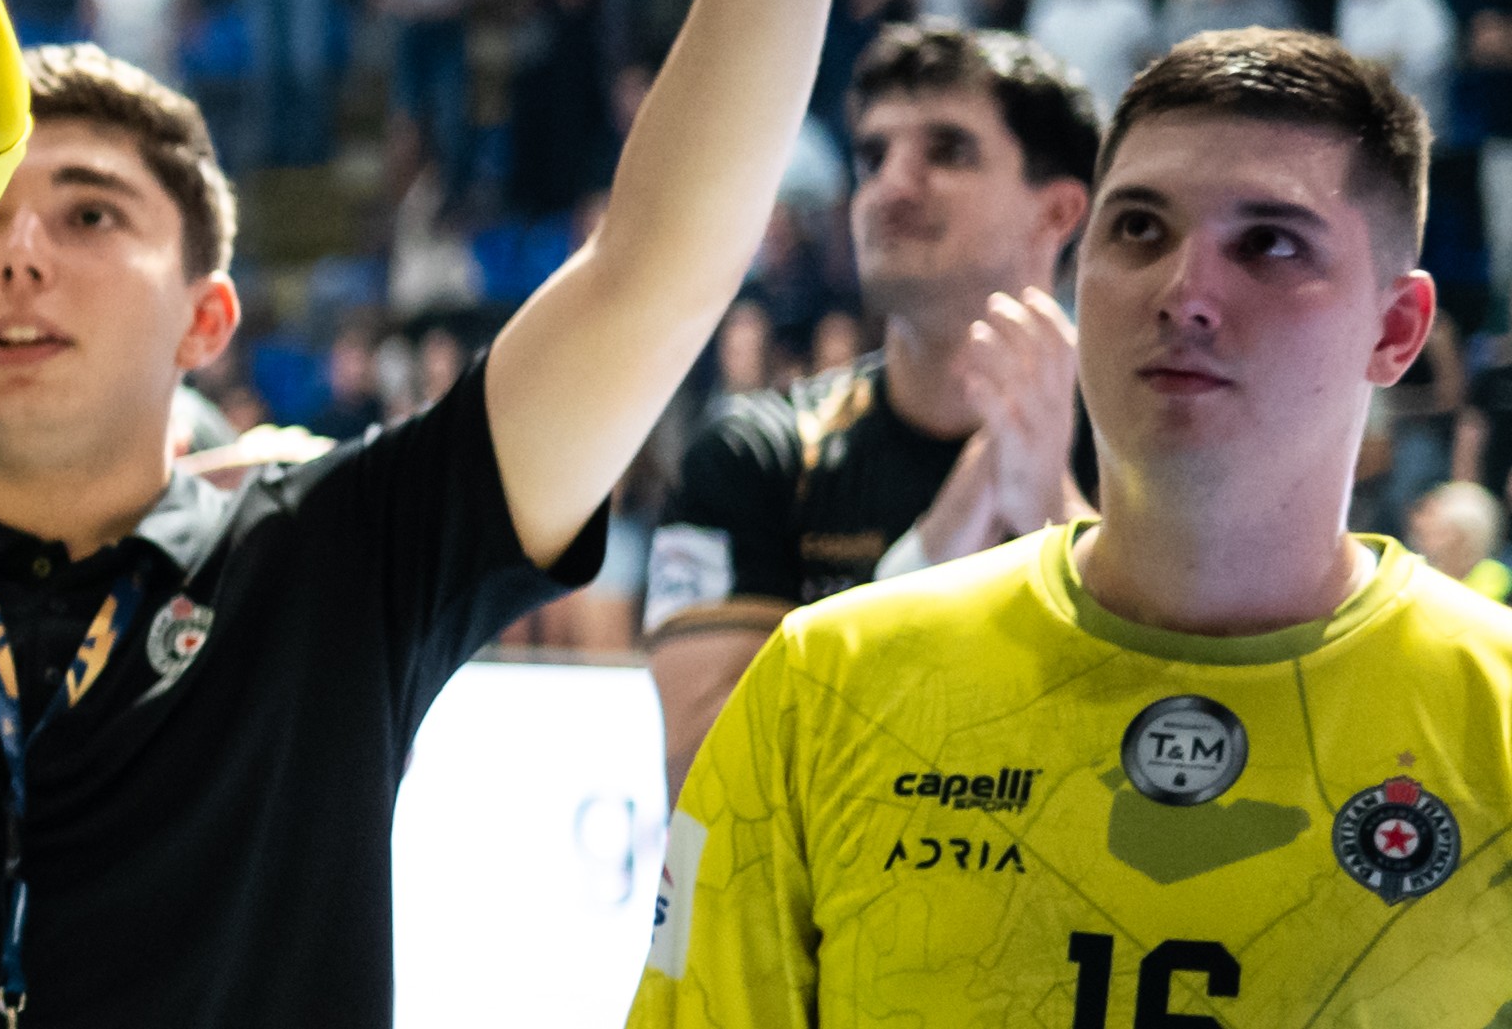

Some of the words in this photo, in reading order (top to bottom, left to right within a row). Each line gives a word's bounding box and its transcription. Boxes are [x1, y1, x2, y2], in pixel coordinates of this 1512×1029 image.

[1148, 732, 1225, 764] T&M
[894, 769, 1034, 805] capelli
[884, 838, 1026, 874] ADRIA
[1068, 932, 1241, 1029] 16
